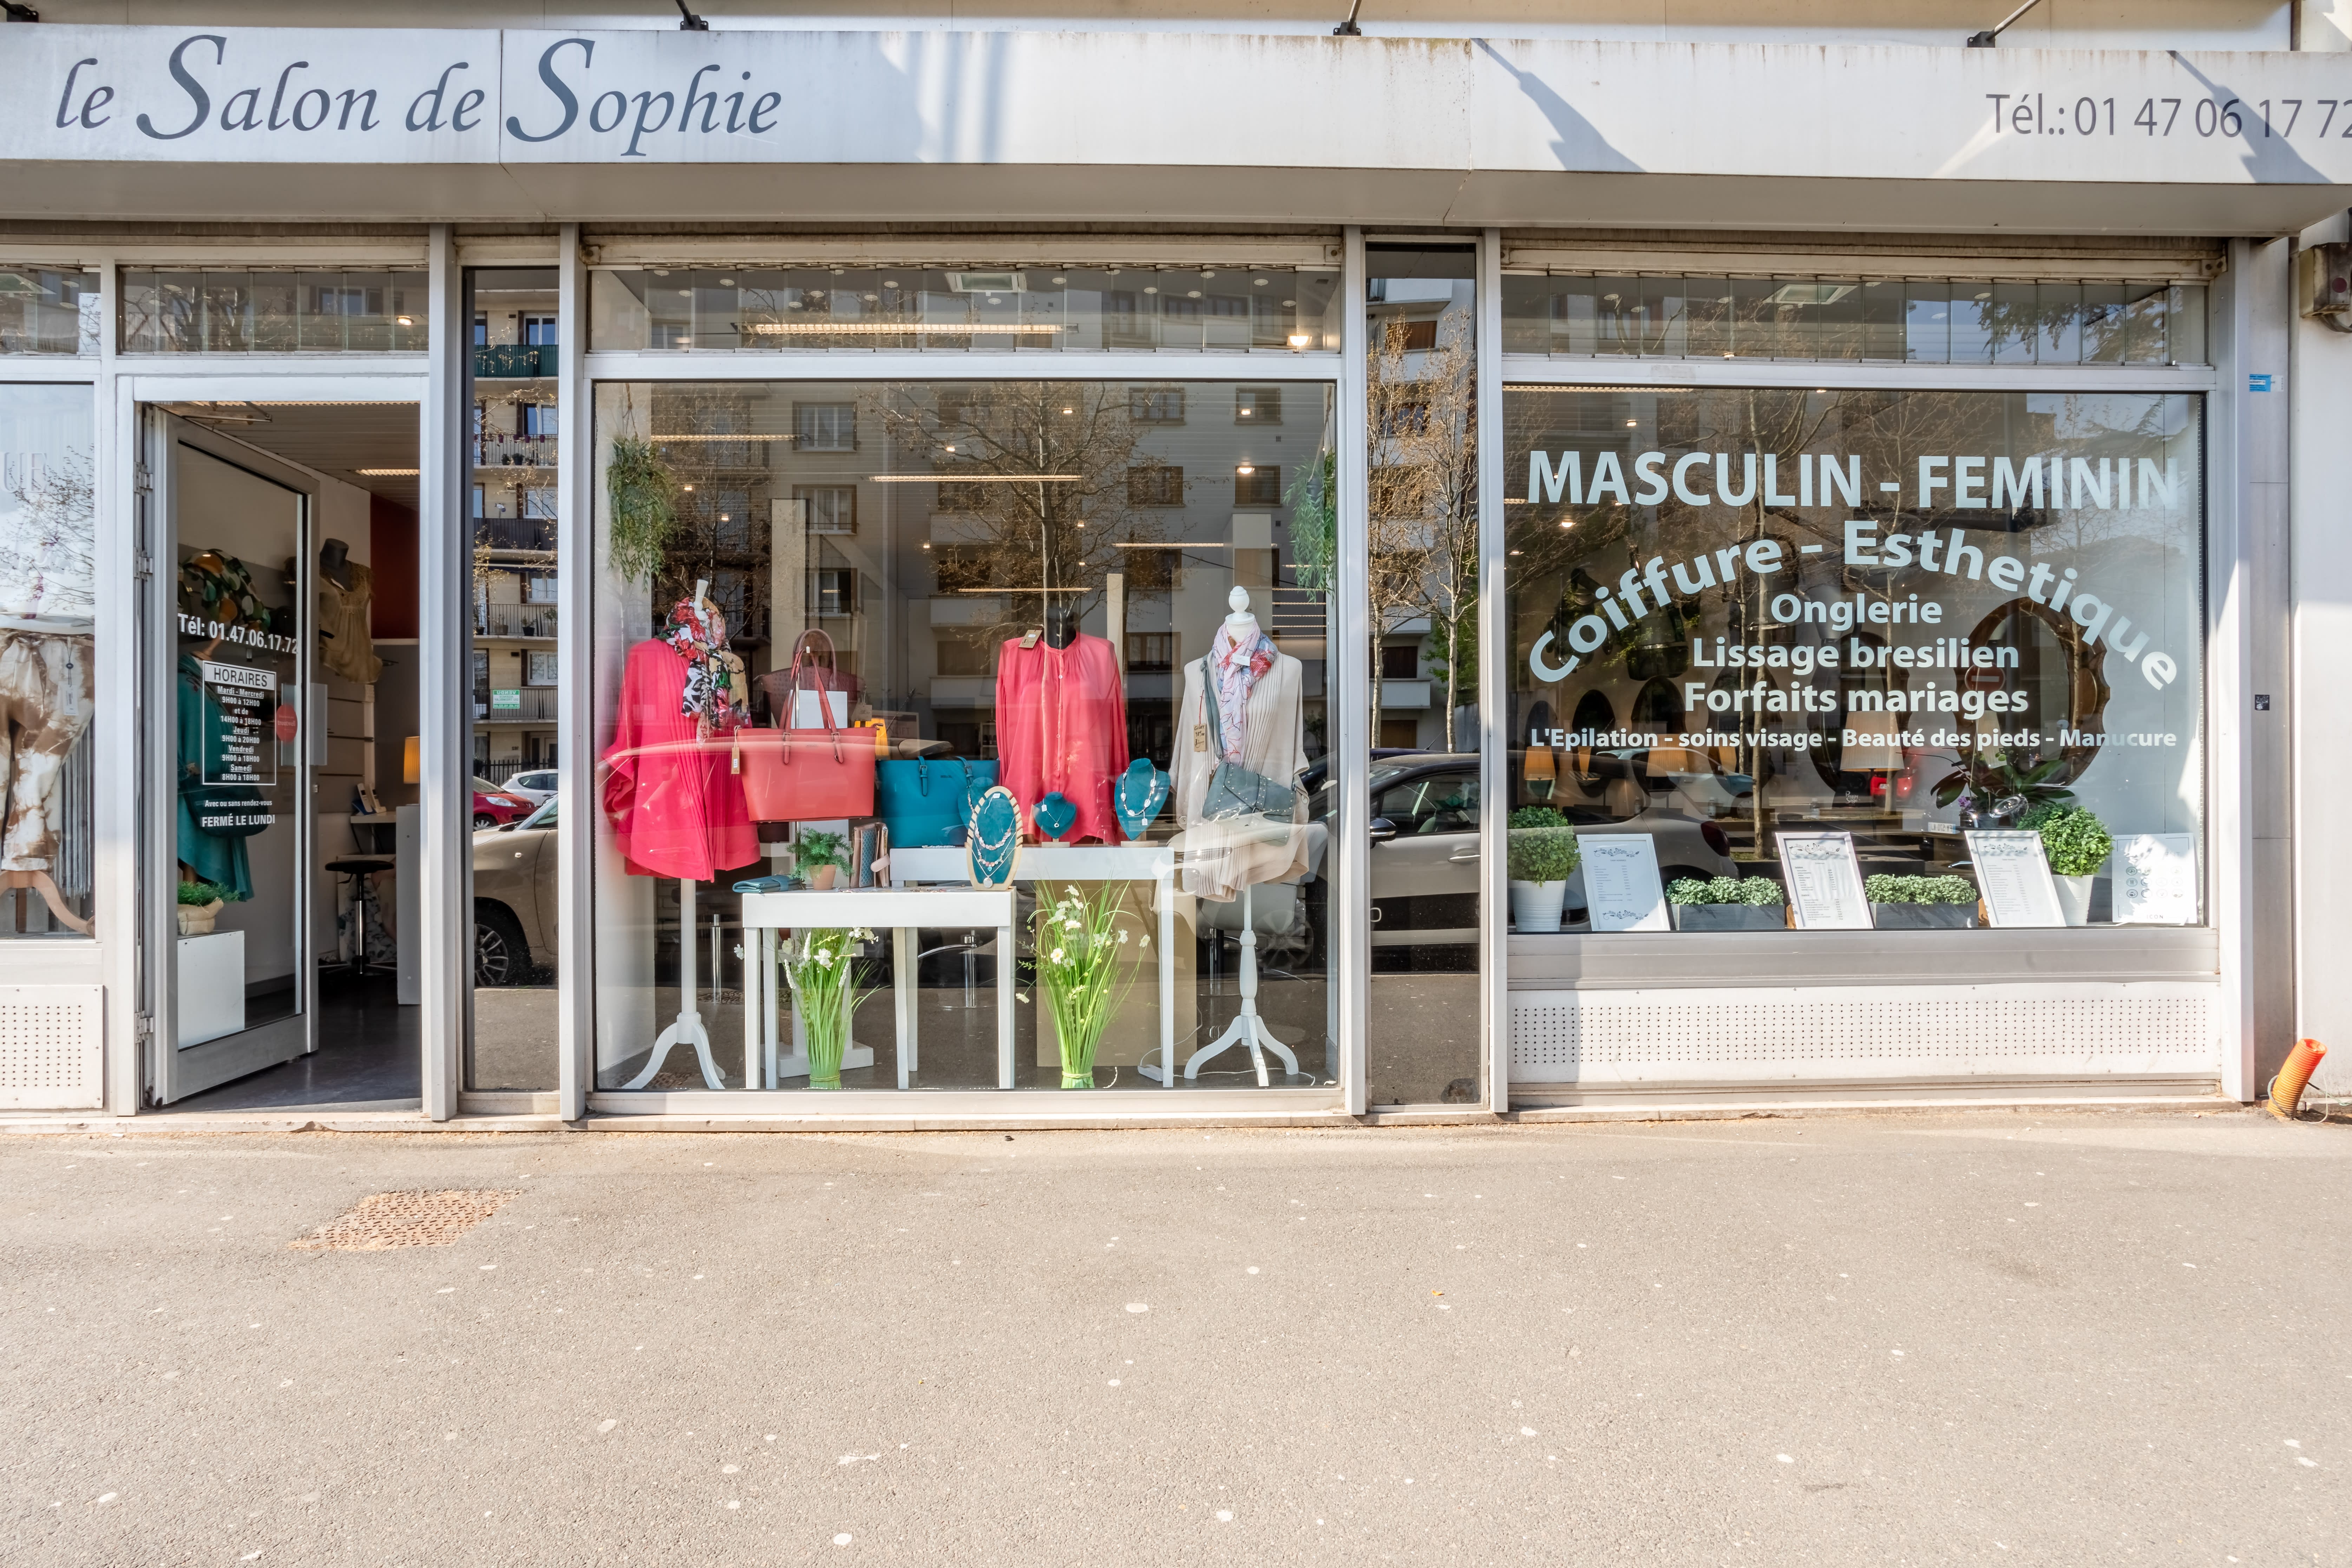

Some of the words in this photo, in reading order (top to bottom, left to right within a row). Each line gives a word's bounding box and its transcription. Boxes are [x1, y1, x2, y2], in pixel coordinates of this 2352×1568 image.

[56, 58, 114, 129] le
[136, 34, 380, 140] Salon
[406, 62, 485, 132] de
[506, 38, 781, 156] Sophie
[2134, 98, 2181, 136] 47
[2195, 98, 2243, 137] 06
[2259, 99, 2302, 138] 17
[1528, 451, 1860, 507] MASCULIN
[1919, 456, 2179, 510] FEMININ
[1529, 539, 1782, 682] Coiffure
[1844, 520, 2177, 690] Esthetique
[1771, 593, 1942, 631] Onglerie
[177, 613, 205, 636] Tél:
[209, 621, 297, 654] 01.47.06.17.72
[1694, 637, 1839, 675] Lissage
[1850, 637, 2018, 668] bresilien
[214, 667, 267, 687] HORAIRES
[217, 685, 235, 694] Mardi
[240, 689, 264, 698] Mercredi
[222, 696, 237, 704] 9H00
[1685, 681, 1837, 712] Forfaits
[1848, 681, 2028, 720] mariages
[229, 745, 254, 753] Vendredi
[1532, 728, 1658, 750] L'Epilation
[1678, 728, 1740, 747] soins
[1745, 728, 1822, 751] visage
[1843, 728, 1925, 747] Beauté
[1930, 728, 1971, 747] des
[1977, 728, 2040, 751] pieds
[2060, 729, 2176, 747] Manucure
[202, 813, 234, 827] FERMÉ
[236, 815, 246, 825] LE
[249, 814, 275, 825] LUNDI
